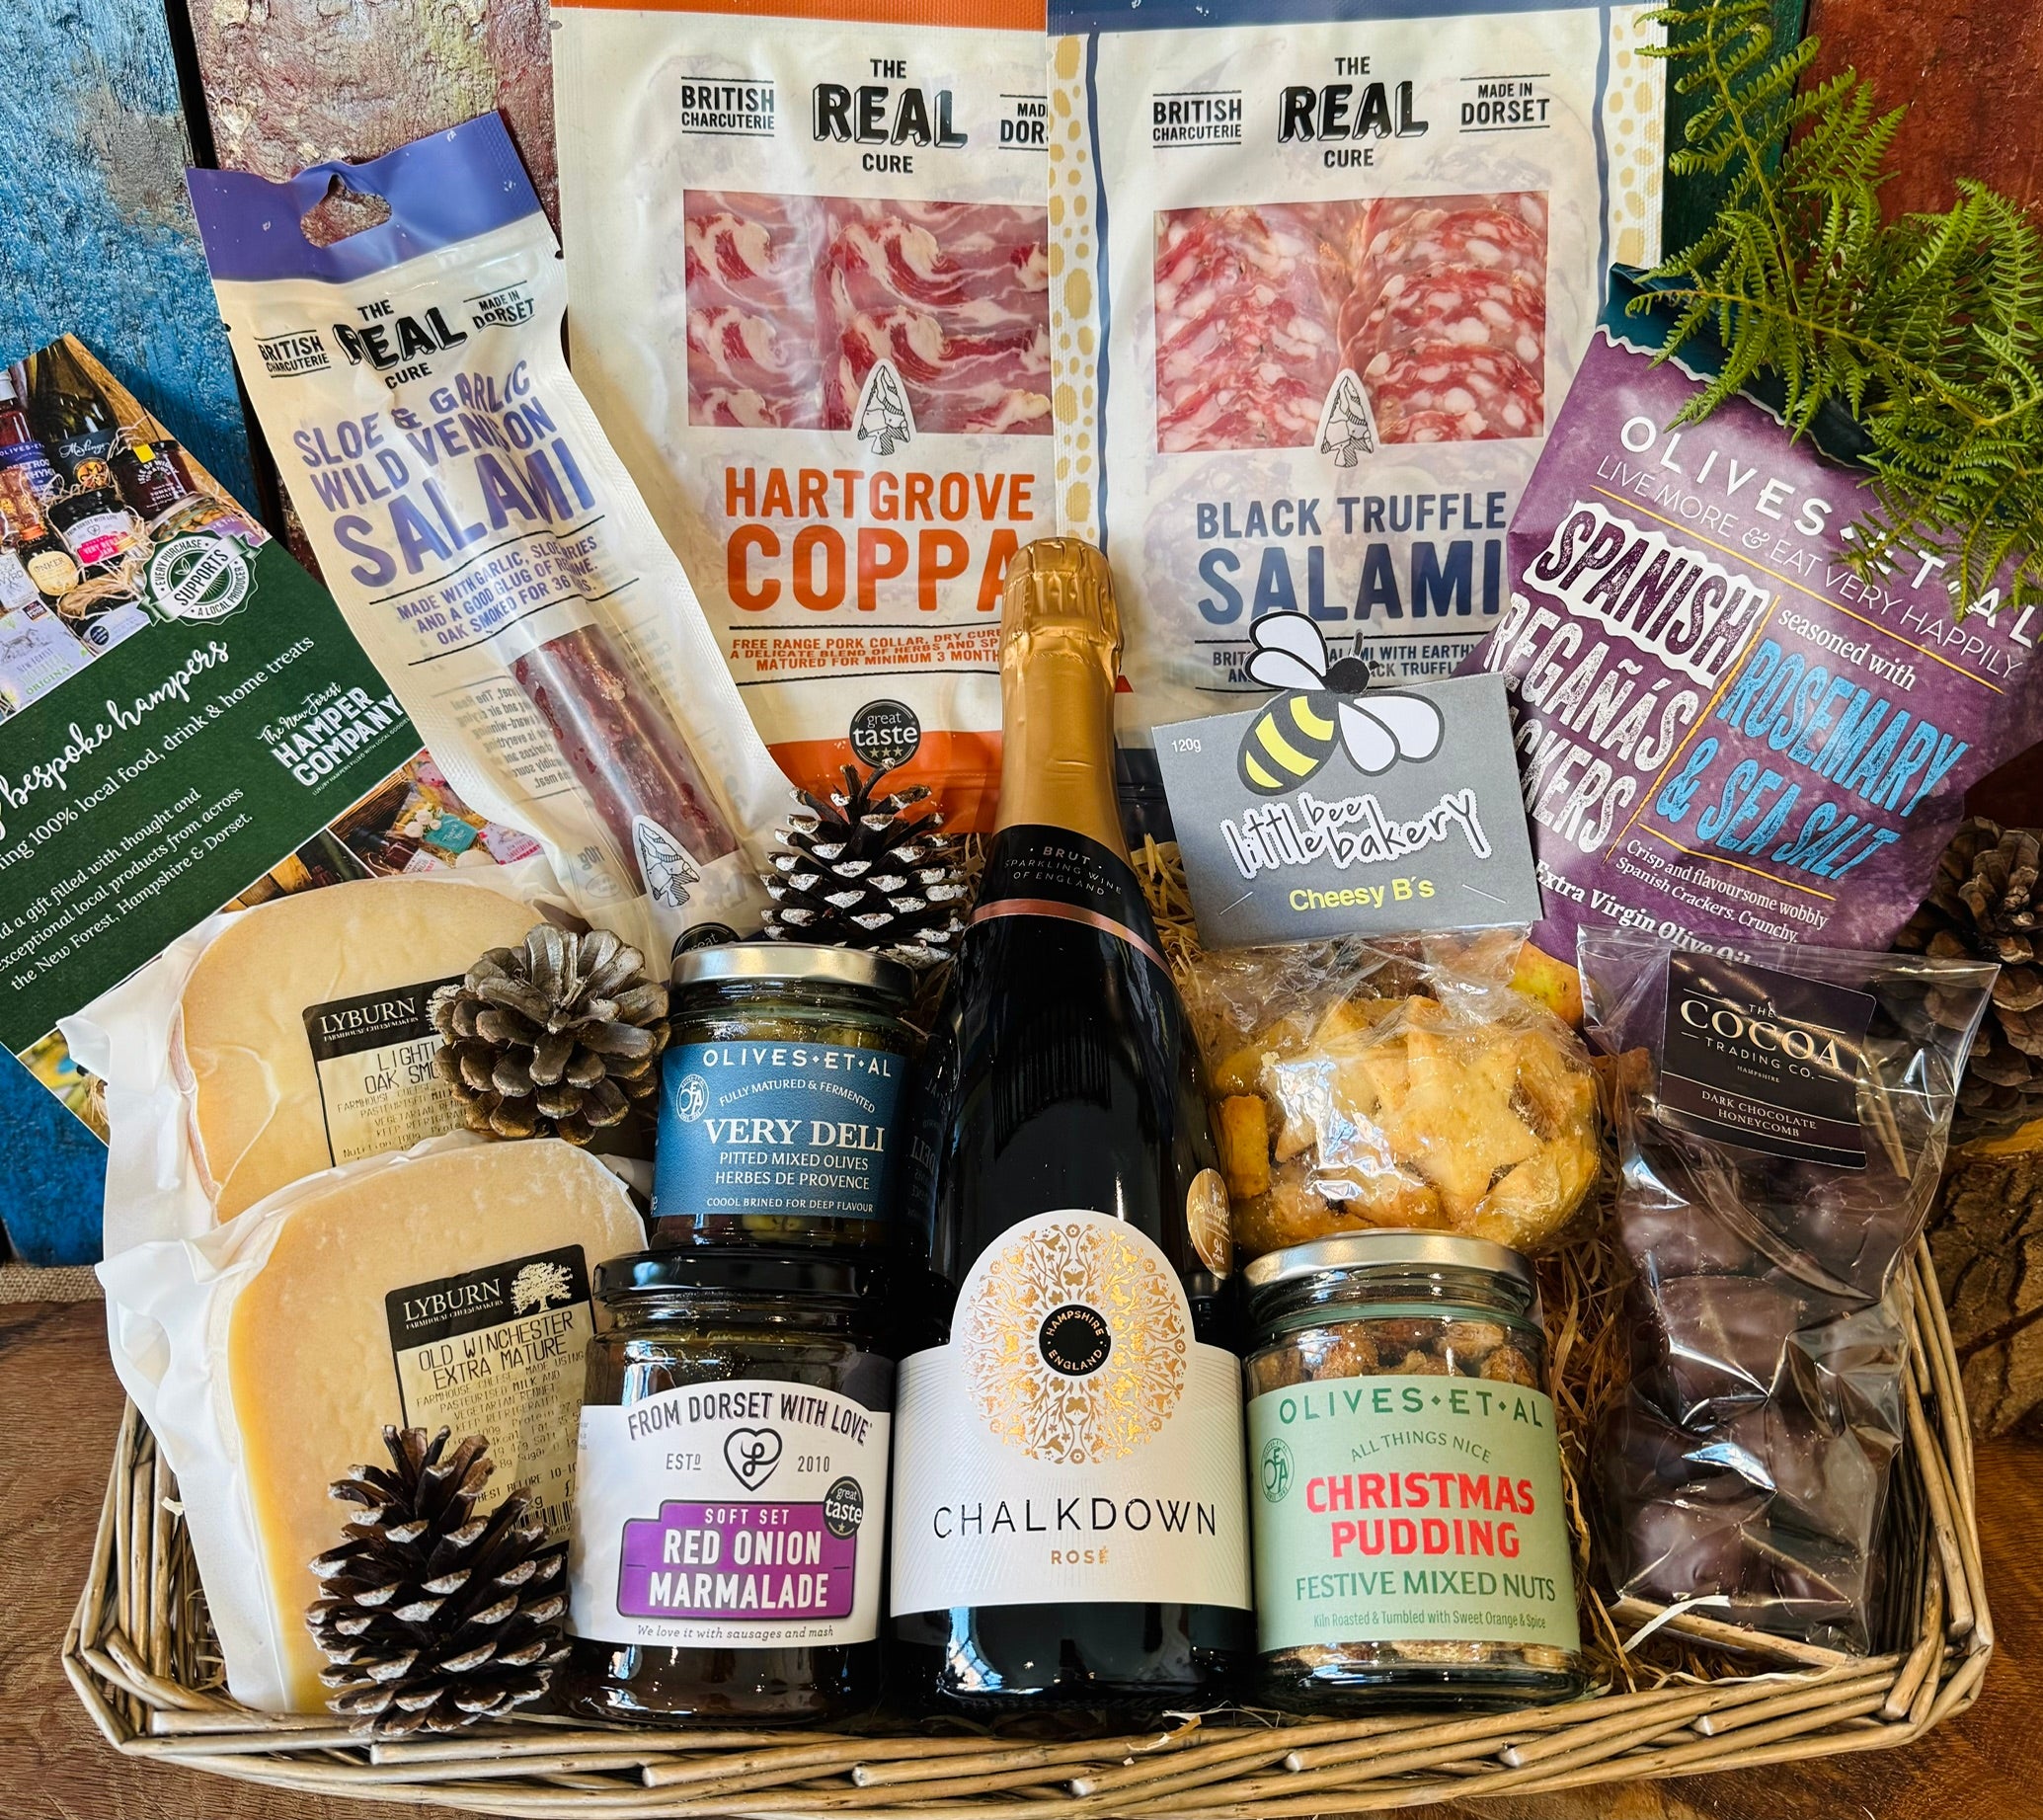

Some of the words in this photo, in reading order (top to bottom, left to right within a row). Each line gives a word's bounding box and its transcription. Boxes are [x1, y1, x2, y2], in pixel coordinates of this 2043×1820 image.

[870, 59, 907, 79] THE
[1335, 56, 1370, 75] THE
[681, 85, 775, 113] BRITISH
[1477, 84, 1516, 99] MADE
[1520, 83, 1532, 97] IN
[681, 112, 775, 129] CHARCUTERIE
[813, 83, 969, 149] REAL
[1153, 99, 1242, 124] BRITISH
[1278, 81, 1429, 143] REAL
[1461, 99, 1549, 125] DORSET
[1152, 123, 1241, 141] CHARCUTERIE
[862, 154, 913, 173] CURE
[1324, 148, 1374, 168] CURE
[357, 300, 394, 322] THE
[473, 298, 535, 328] DORSET
[479, 294, 508, 311] MADE
[508, 290, 519, 302] IN
[258, 336, 325, 361] BRITISH
[332, 307, 468, 370] REAL
[266, 354, 330, 372] CHARCUTERIE
[384, 362, 432, 389] CURE
[293, 413, 384, 468] SLOE
[391, 407, 423, 430] &
[430, 360, 531, 416] GARLIC
[310, 448, 410, 513] WILD
[406, 396, 557, 466] VENISON
[333, 436, 595, 588] SALAMI
[726, 467, 1035, 521] HARTGROVE
[1197, 498, 1321, 539] BLACK
[1337, 492, 1507, 533] TRUFFLE
[155, 562, 166, 586] EVERY
[162, 539, 201, 564] PURCHASE
[174, 549, 228, 605] SUPPORTS
[728, 524, 1019, 612] COPPA
[1597, 455, 1655, 497] LIVE
[1655, 484, 1739, 537] MORE
[1742, 527, 1769, 550] &
[1769, 539, 1823, 577] EAT
[1825, 565, 1902, 615] VERY
[1900, 605, 2023, 679] HAPPILY
[1198, 539, 1501, 625] SALAMI
[1534, 510, 1764, 675] SPANISH
[733, 639, 767, 650] FREE
[773, 638, 821, 650] RANGE
[826, 638, 863, 649] PORK
[870, 637, 928, 648] COLLAR,
[934, 633, 961, 642] DRY
[1778, 608, 1869, 666] seasoned
[1869, 659, 1917, 691] with
[0, 722, 113, 809] bespoke
[107, 641, 230, 731] hampers
[272, 686, 374, 768] HAMPER
[853, 723, 918, 746] taste
[867, 712, 901, 729] great
[1716, 638, 1969, 818] ROSEMARY
[29, 807, 78, 845] 100%
[74, 776, 120, 812] local
[118, 738, 166, 784] food,
[163, 716, 207, 752] drink
[207, 704, 224, 720] &
[222, 671, 269, 709] home
[266, 637, 315, 673] treats
[292, 694, 403, 786] COMPANY
[1172, 738, 1202, 753] 120g
[1301, 796, 1364, 828] bee
[1656, 737, 1719, 823] &
[1696, 759, 1801, 855] SEA
[1770, 802, 1901, 880] SALT
[1224, 806, 1324, 875] little
[1325, 792, 1488, 865] bakery
[1043, 846, 1090, 865] BRUT
[11, 970, 37, 990] the
[35, 946, 70, 972] New
[69, 913, 120, 948] Forest,
[116, 857, 194, 915] Hampshire
[191, 846, 205, 863] &
[203, 815, 253, 851] Dorset.
[1290, 885, 1384, 911] Cheesy
[1615, 857, 1671, 893] Spanish
[1672, 888, 1734, 921] Crackers.
[1739, 910, 1798, 944] Crunchy.
[1627, 839, 1664, 869] Crisp
[1664, 861, 1691, 881] and
[1691, 868, 1777, 910] flavoursome
[1779, 903, 1829, 931] wobbly
[320, 997, 416, 1034] LYBURN
[1749, 1004, 1774, 1017] THE
[1681, 999, 1841, 1070] COCOA
[703, 1049, 808, 1067] OLIVES
[824, 1052, 855, 1070] ET
[869, 1058, 891, 1076] AL
[1705, 1037, 1780, 1068] TRADING
[1788, 1063, 1815, 1079] CO.
[1738, 1066, 1779, 1082] HAMPSHIRE
[1701, 1090, 1735, 1108] DARK
[1739, 1104, 1817, 1130] CHOCOLATE
[1718, 1109, 1799, 1137] HONEYCOMB
[703, 1118, 802, 1145] VERY
[810, 1121, 885, 1152] DELI
[720, 1152, 768, 1165] PITTED
[771, 1153, 820, 1166] MIXED
[824, 1155, 868, 1171] OLIVES
[707, 1198, 741, 1207] COOOL
[743, 1198, 782, 1208] BRINED
[786, 1199, 806, 1208] FOR
[810, 1199, 833, 1210] DEEP
[837, 1202, 873, 1213] FLAVOUR
[403, 1278, 502, 1322] LYBURN
[419, 1344, 453, 1372] OLD
[464, 1309, 574, 1359] WINCHESTER
[1046, 1310, 1105, 1337] HAMPSHIRE
[432, 1363, 492, 1390] EXTRA
[501, 1333, 568, 1372] MATURE
[1049, 1348, 1103, 1371] ENGLAND
[628, 1399, 679, 1440] FROM
[689, 1392, 772, 1423] DORSET
[780, 1392, 828, 1426] WITH
[830, 1407, 868, 1446] LOVE
[1280, 1386, 1424, 1424] OLIVES
[1449, 1388, 1493, 1416] ET
[1513, 1397, 1542, 1428] AL
[797, 1456, 830, 1472] 2010
[1306, 1471, 1534, 1515] CHRISTMAS
[705, 1508, 748, 1525] SOFT
[759, 1509, 789, 1525] SET
[933, 1497, 1216, 1538] CHALKDOWN
[664, 1530, 720, 1565] RED
[734, 1531, 822, 1565] ONION
[1052, 1545, 1109, 1564] ROSÉ
[1331, 1518, 1520, 1557] PUDDING
[650, 1571, 828, 1609] MARMALADE
[1297, 1571, 1395, 1601] FESTIVE
[1404, 1570, 1497, 1596] MIXED
[1504, 1575, 1556, 1602] NUTS
[638, 1624, 653, 1636] We
[656, 1625, 680, 1637] love
[683, 1627, 694, 1637] it
[697, 1627, 723, 1638] with
[727, 1628, 781, 1641] sausages
[784, 1626, 806, 1637] and
[809, 1625, 832, 1636] mash
[1314, 1614, 1330, 1628] Kiln
[1333, 1611, 1371, 1626] Roasted
[1373, 1611, 1378, 1623] &
[1381, 1610, 1425, 1624] Tumbled
[1427, 1610, 1451, 1624] with
[1454, 1610, 1482, 1624] Sweet
[1485, 1612, 1517, 1628] Orange
[1519, 1616, 1525, 1627] &
[1527, 1617, 1546, 1630] Spice
